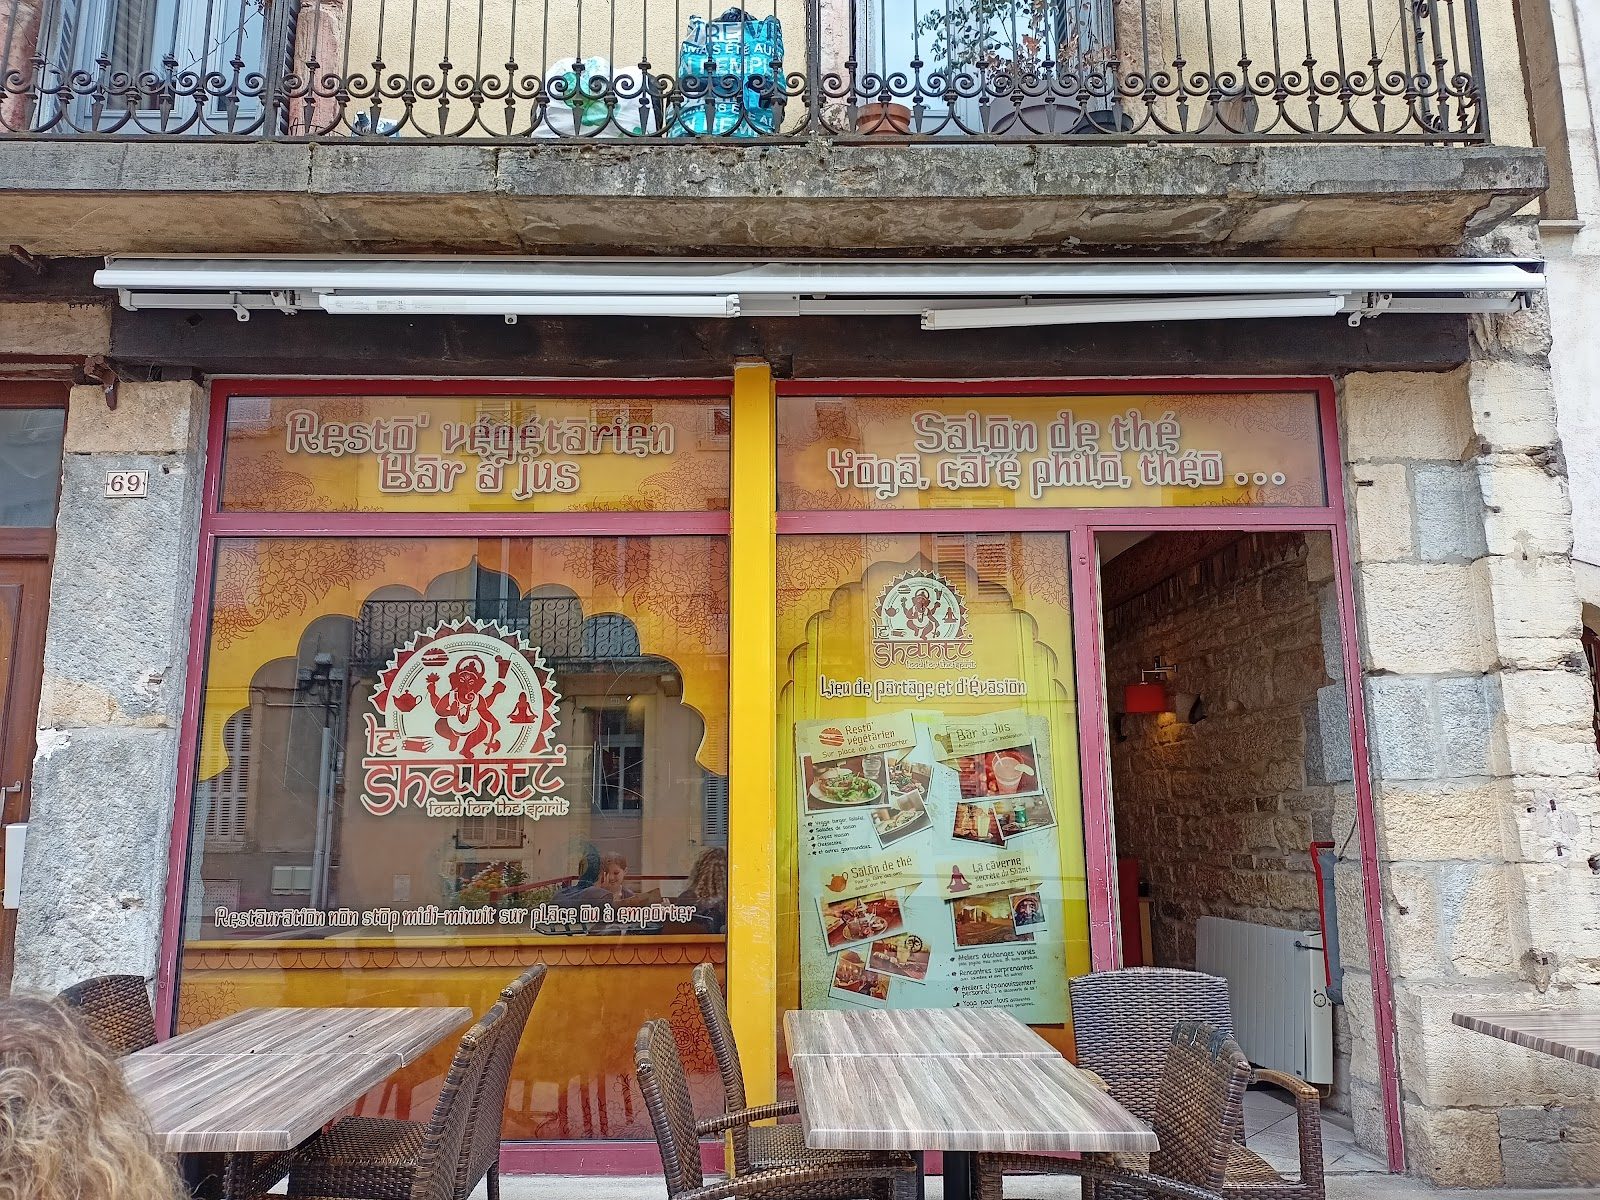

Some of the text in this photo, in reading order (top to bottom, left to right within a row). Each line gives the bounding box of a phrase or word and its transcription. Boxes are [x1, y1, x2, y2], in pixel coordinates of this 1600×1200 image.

[1048, 408, 1099, 455] de
[1108, 407, 1180, 454] thé
[110, 474, 140, 491] 69
[512, 455, 580, 501] jus
[820, 674, 851, 699] Lieu
[853, 677, 872, 697] de
[937, 680, 954, 697] et
[981, 726, 988, 736] à
[427, 797, 569, 820] food for the spirit
[882, 860, 894, 871] de
[896, 855, 912, 868] thé
[985, 857, 1022, 871] caverne
[402, 904, 496, 926] midi-minuit
[498, 907, 528, 924] sur
[579, 904, 600, 923] ou
[602, 903, 615, 923] à
